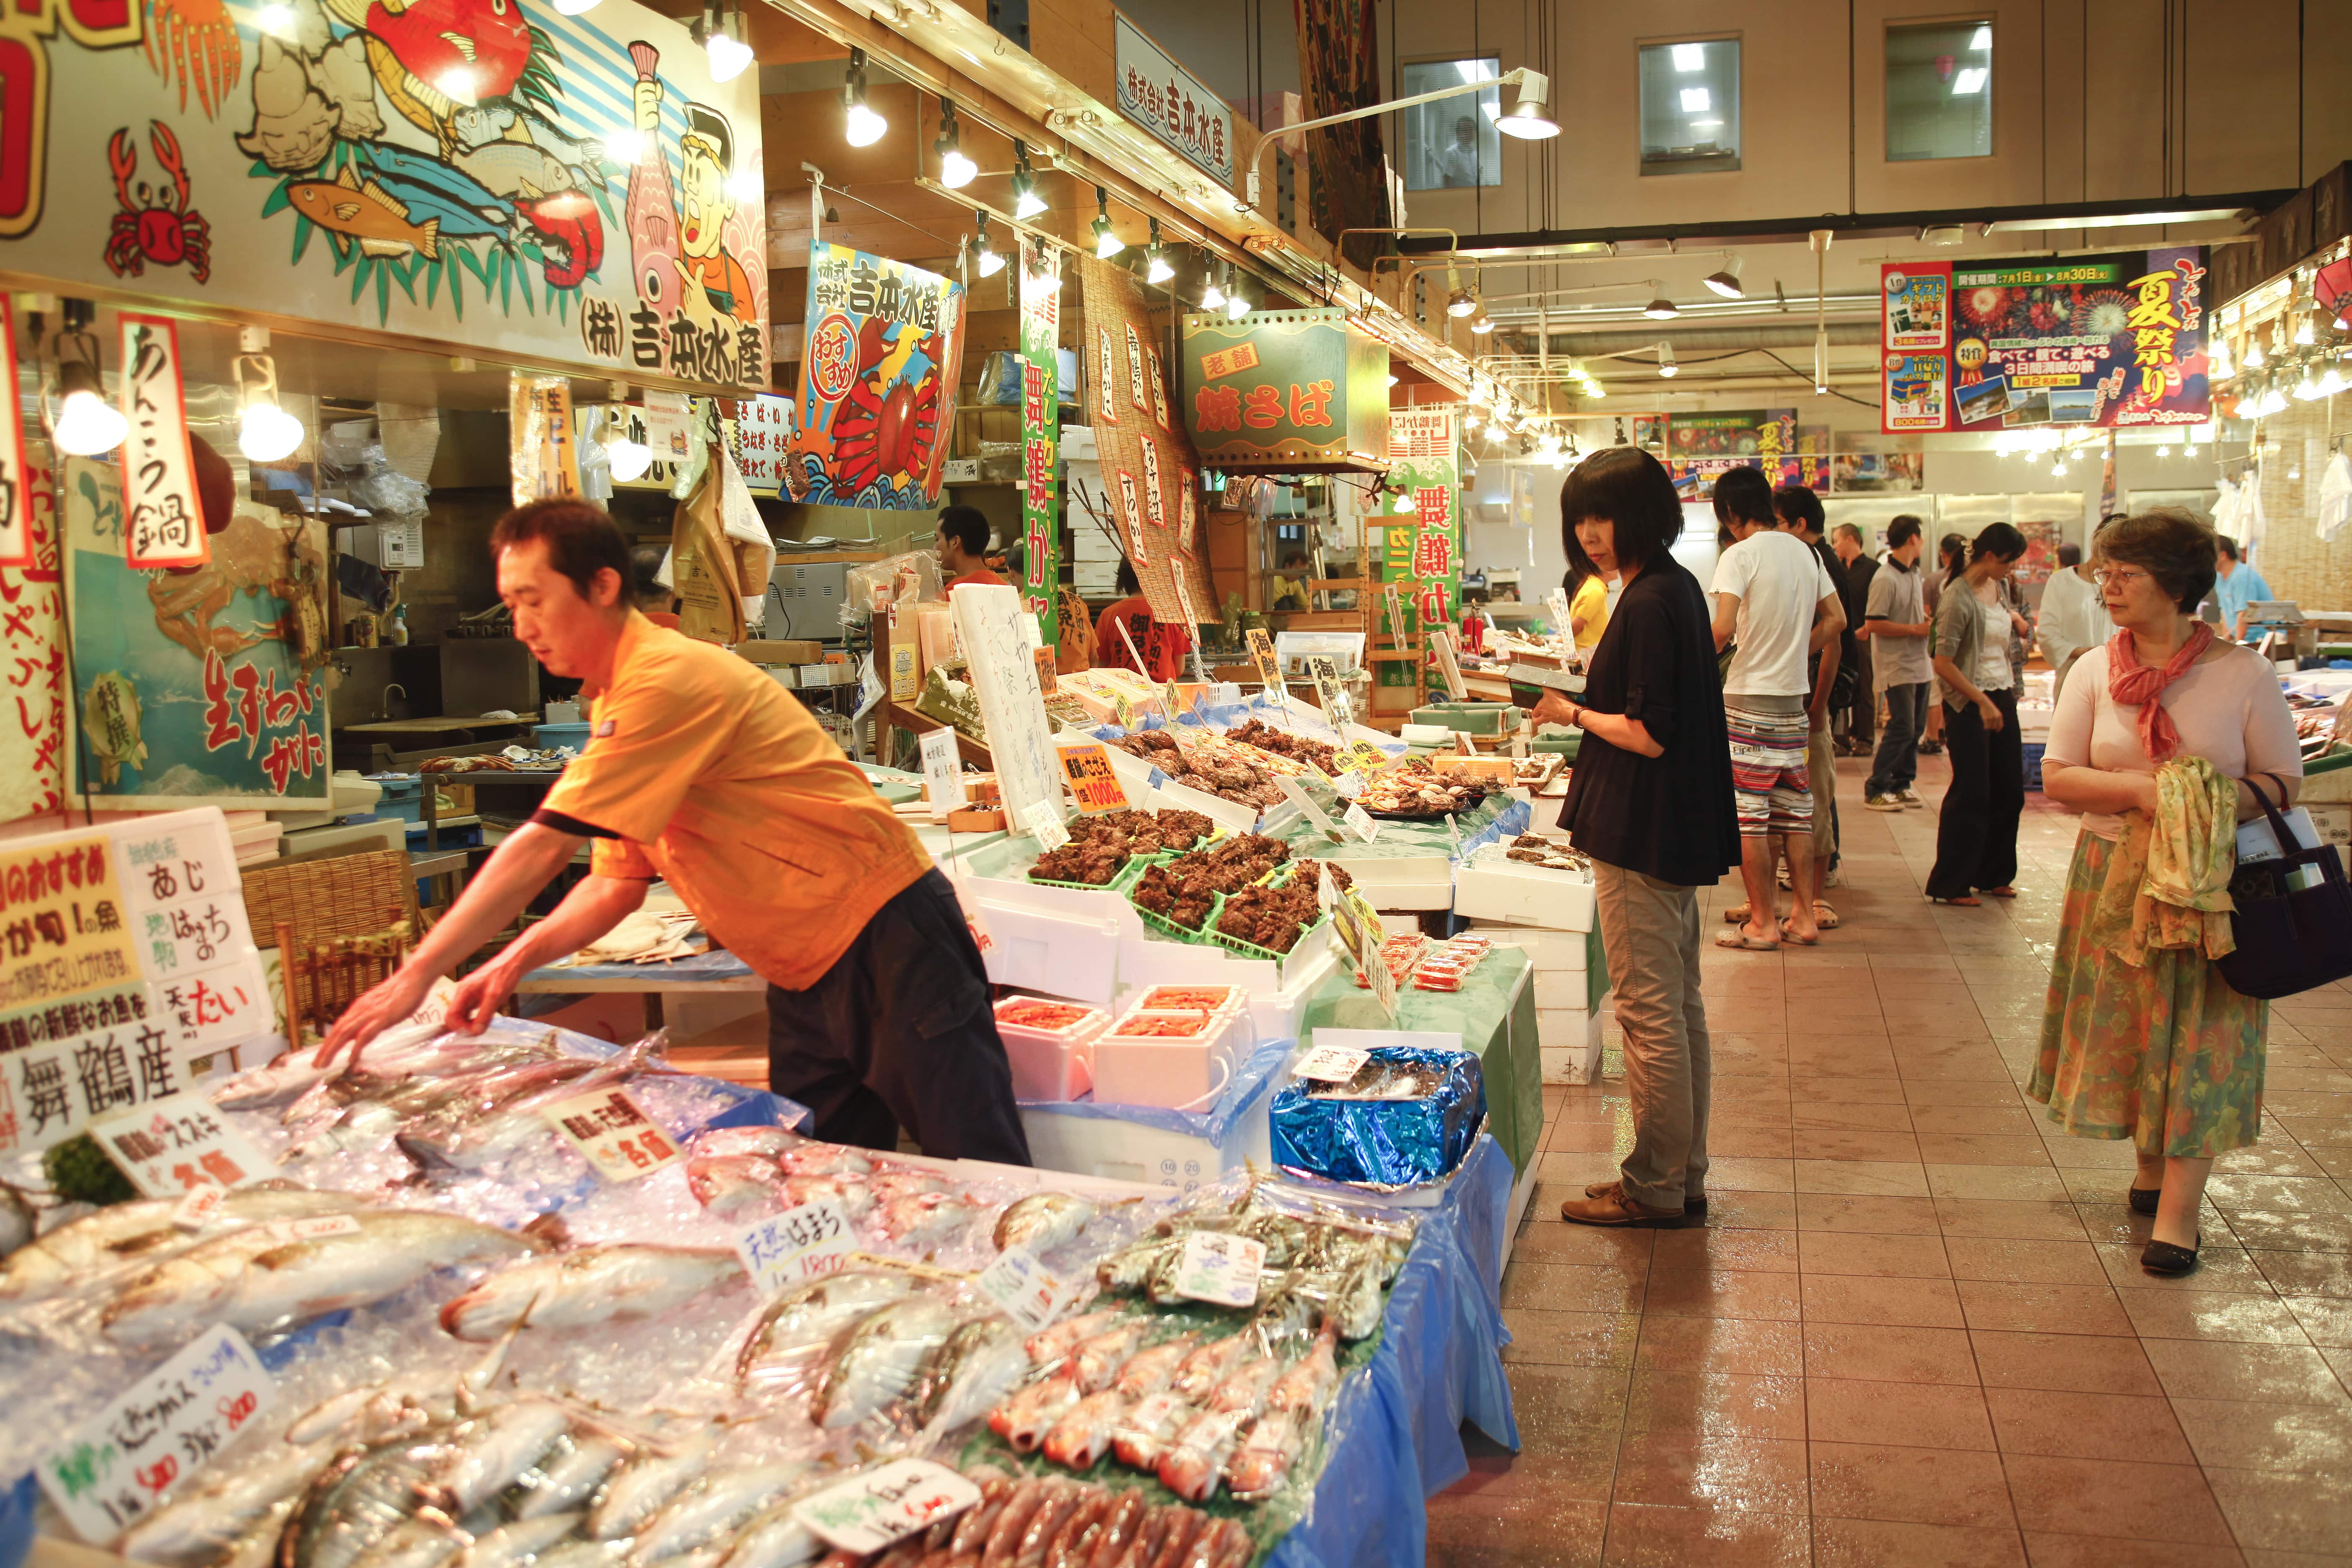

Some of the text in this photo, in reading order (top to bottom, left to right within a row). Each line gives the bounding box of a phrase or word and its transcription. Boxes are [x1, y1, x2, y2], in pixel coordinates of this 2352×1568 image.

[1128, 64, 1225, 167] 株式会社吉本水産
[848, 260, 940, 333] 吉本水産
[1901, 293, 1944, 304] カタログ
[1911, 283, 1943, 294] ギフト
[2175, 259, 2206, 332] とれとれ
[581, 298, 763, 386] (株)吉本水産
[1128, 327, 1144, 409] 舞鶴かに
[1207, 346, 1252, 376] 老舗
[1960, 348, 1981, 361] 特賞
[2127, 270, 2182, 404] 夏祭り
[1101, 334, 1112, 416] 松葉かに
[1196, 379, 1334, 432] 焼さば
[547, 386, 574, 496] 生ビール
[1756, 421, 1784, 489] 夏祭り
[204, 647, 323, 759] 生ずわい
[894, 677, 915, 695] 加盟店
[263, 720, 324, 794] がに
[0, 843, 106, 912] のおすすめ
[148, 861, 204, 901] あじ
[0, 900, 121, 960] が旬!の魚
[188, 979, 248, 1026] たい
[22, 1024, 180, 1136] 舞鶴産
